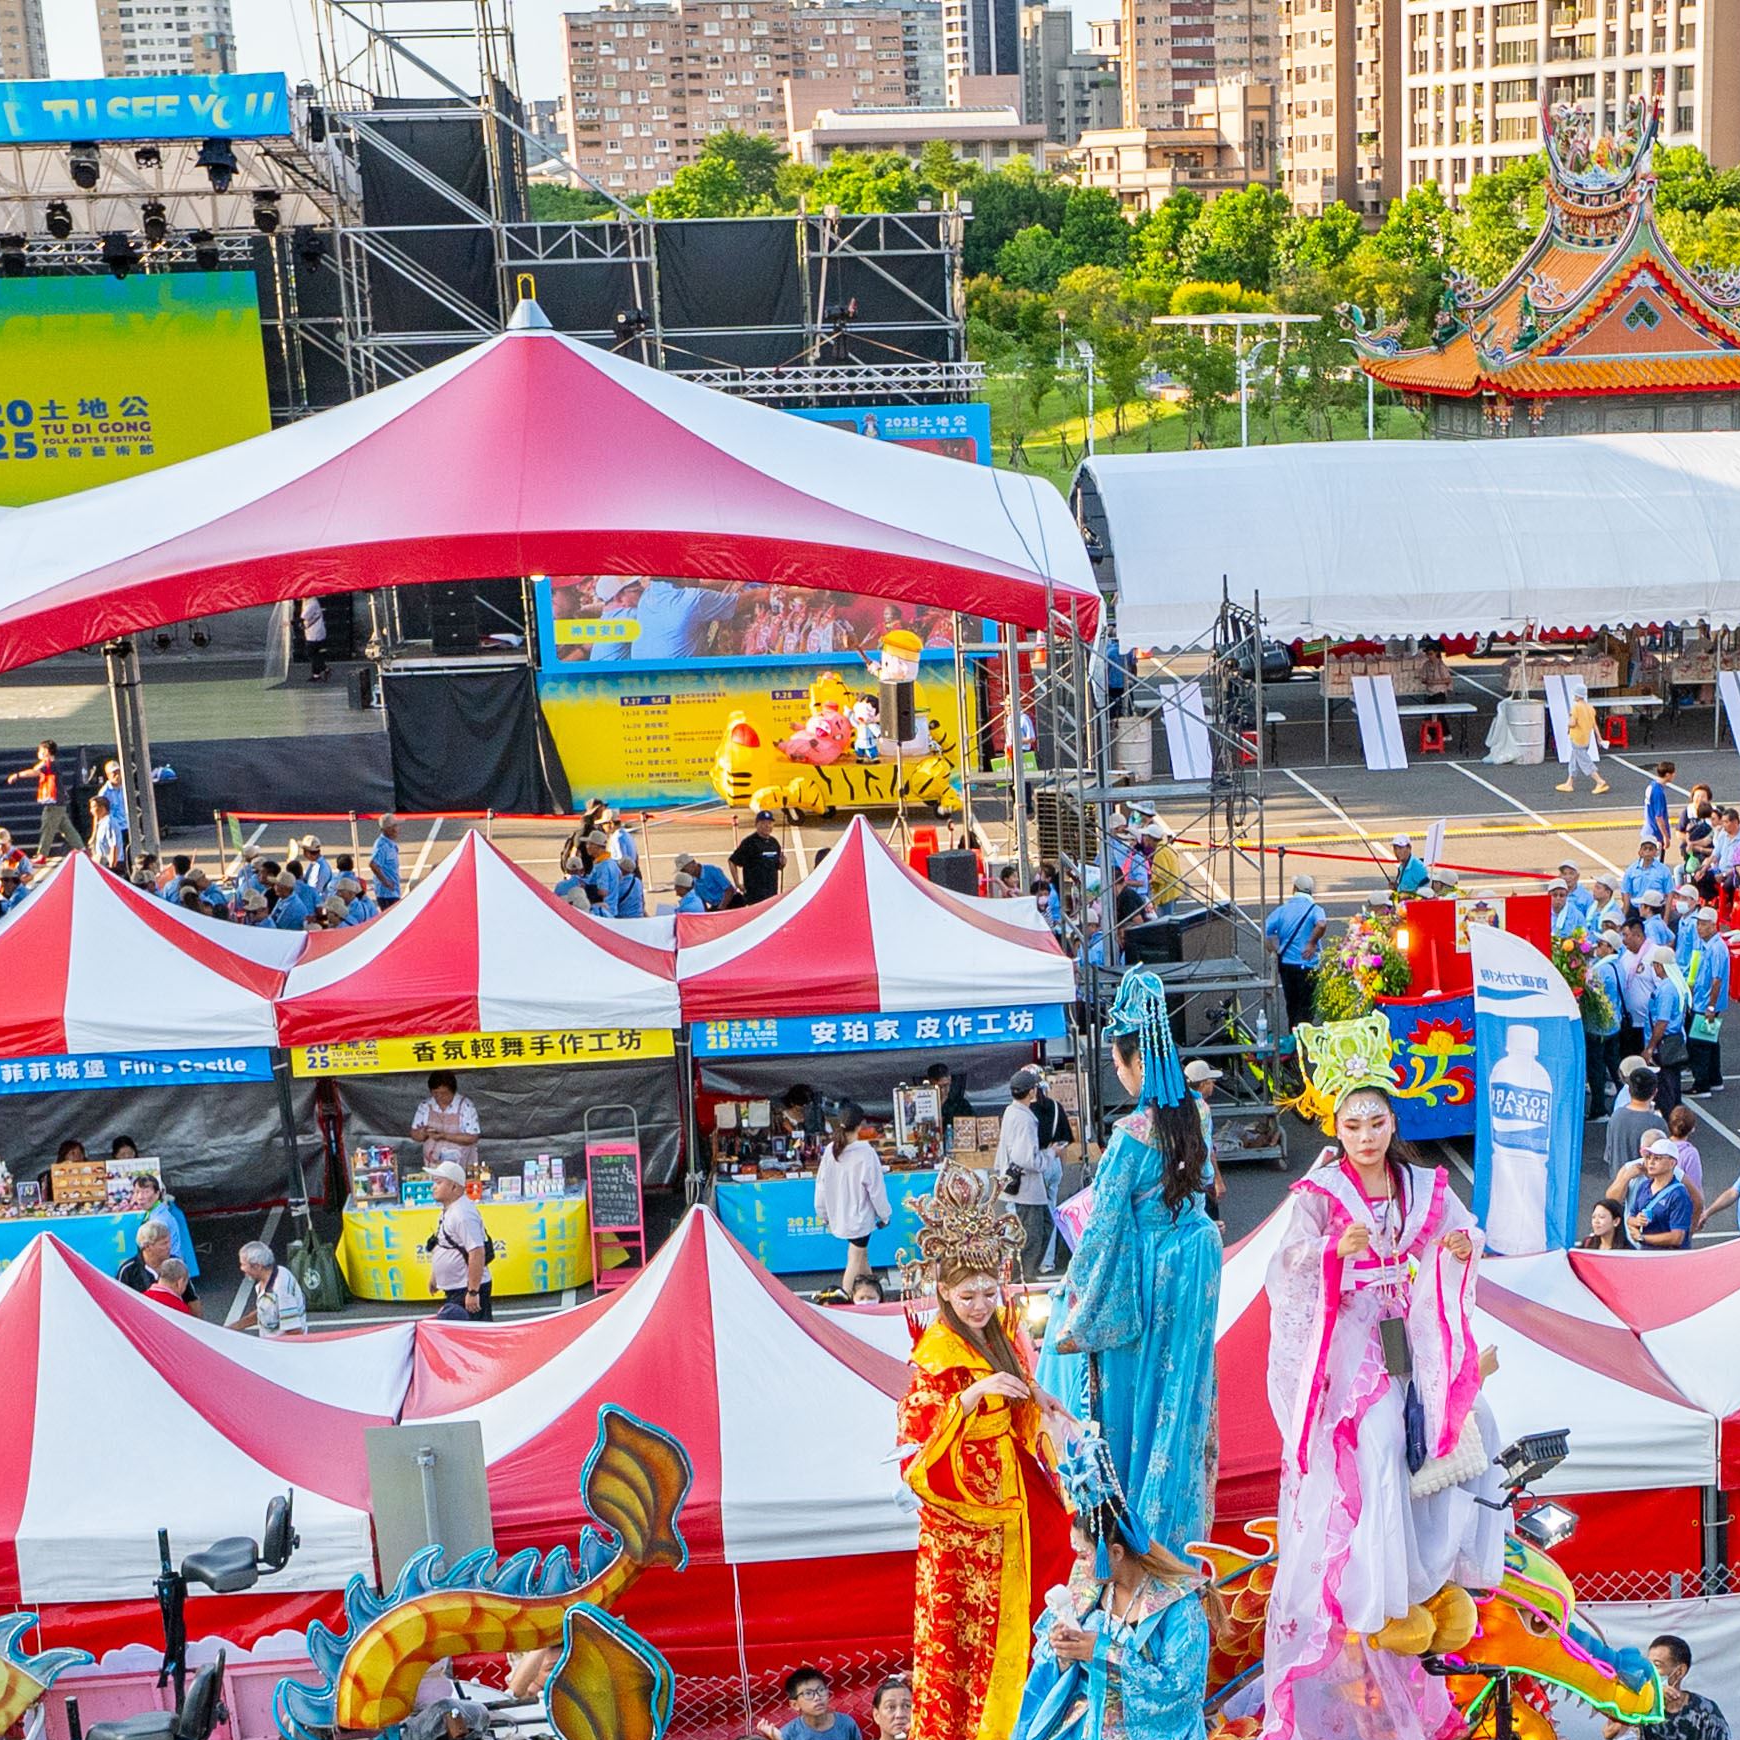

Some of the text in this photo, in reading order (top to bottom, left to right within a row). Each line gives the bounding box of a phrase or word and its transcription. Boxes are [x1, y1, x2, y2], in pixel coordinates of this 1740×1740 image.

[39, 396, 149, 421] 土地公
[41, 421, 152, 435] TU DI GONG
[884, 414, 968, 428] 2025 土地公
[44, 444, 155, 459] 民俗藝術節
[810, 1018, 901, 1045] 安珀家
[915, 1010, 1035, 1040] 皮作工坊
[411, 1028, 642, 1063] 香氛輕舞手作工坊
[0, 1059, 108, 1084] 菲菲城堡
[177, 1056, 248, 1073] Castle
[307, 1056, 330, 1069] 25
